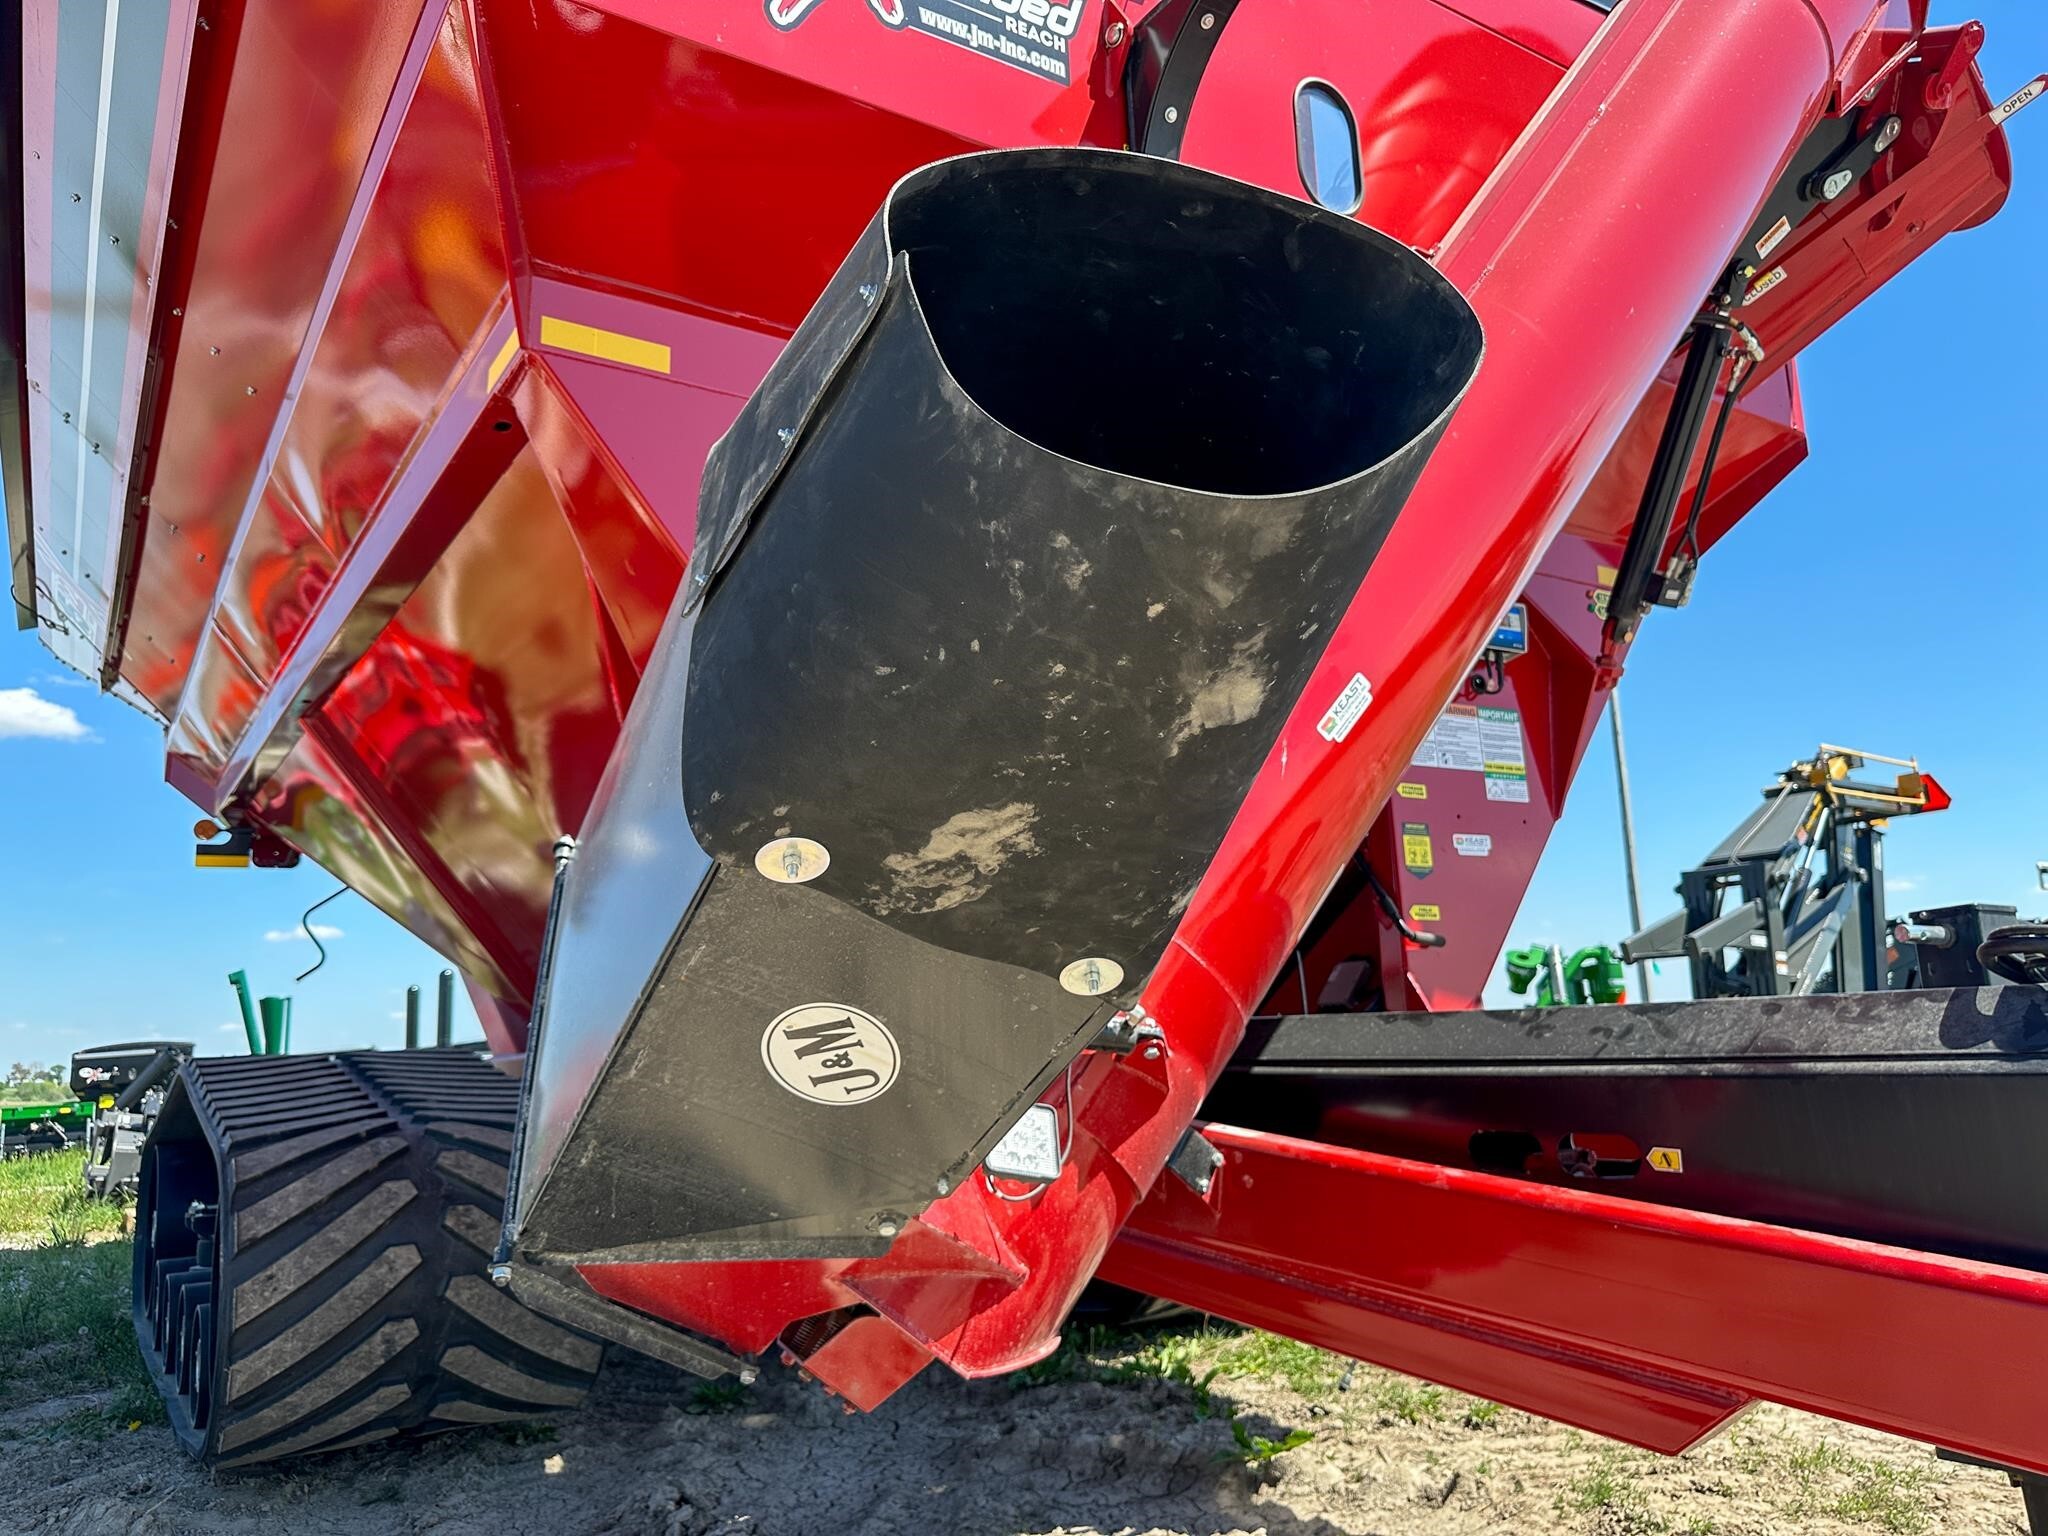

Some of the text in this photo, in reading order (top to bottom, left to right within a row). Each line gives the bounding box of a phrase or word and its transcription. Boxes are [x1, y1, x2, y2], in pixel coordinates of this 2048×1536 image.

[1005, 15, 1066, 53] REACH
[2002, 89, 2033, 113] OPEN
[1332, 677, 1364, 717] KEAST
[1477, 708, 1519, 722] IMPORTANT
[782, 1016, 880, 1095] J&M
